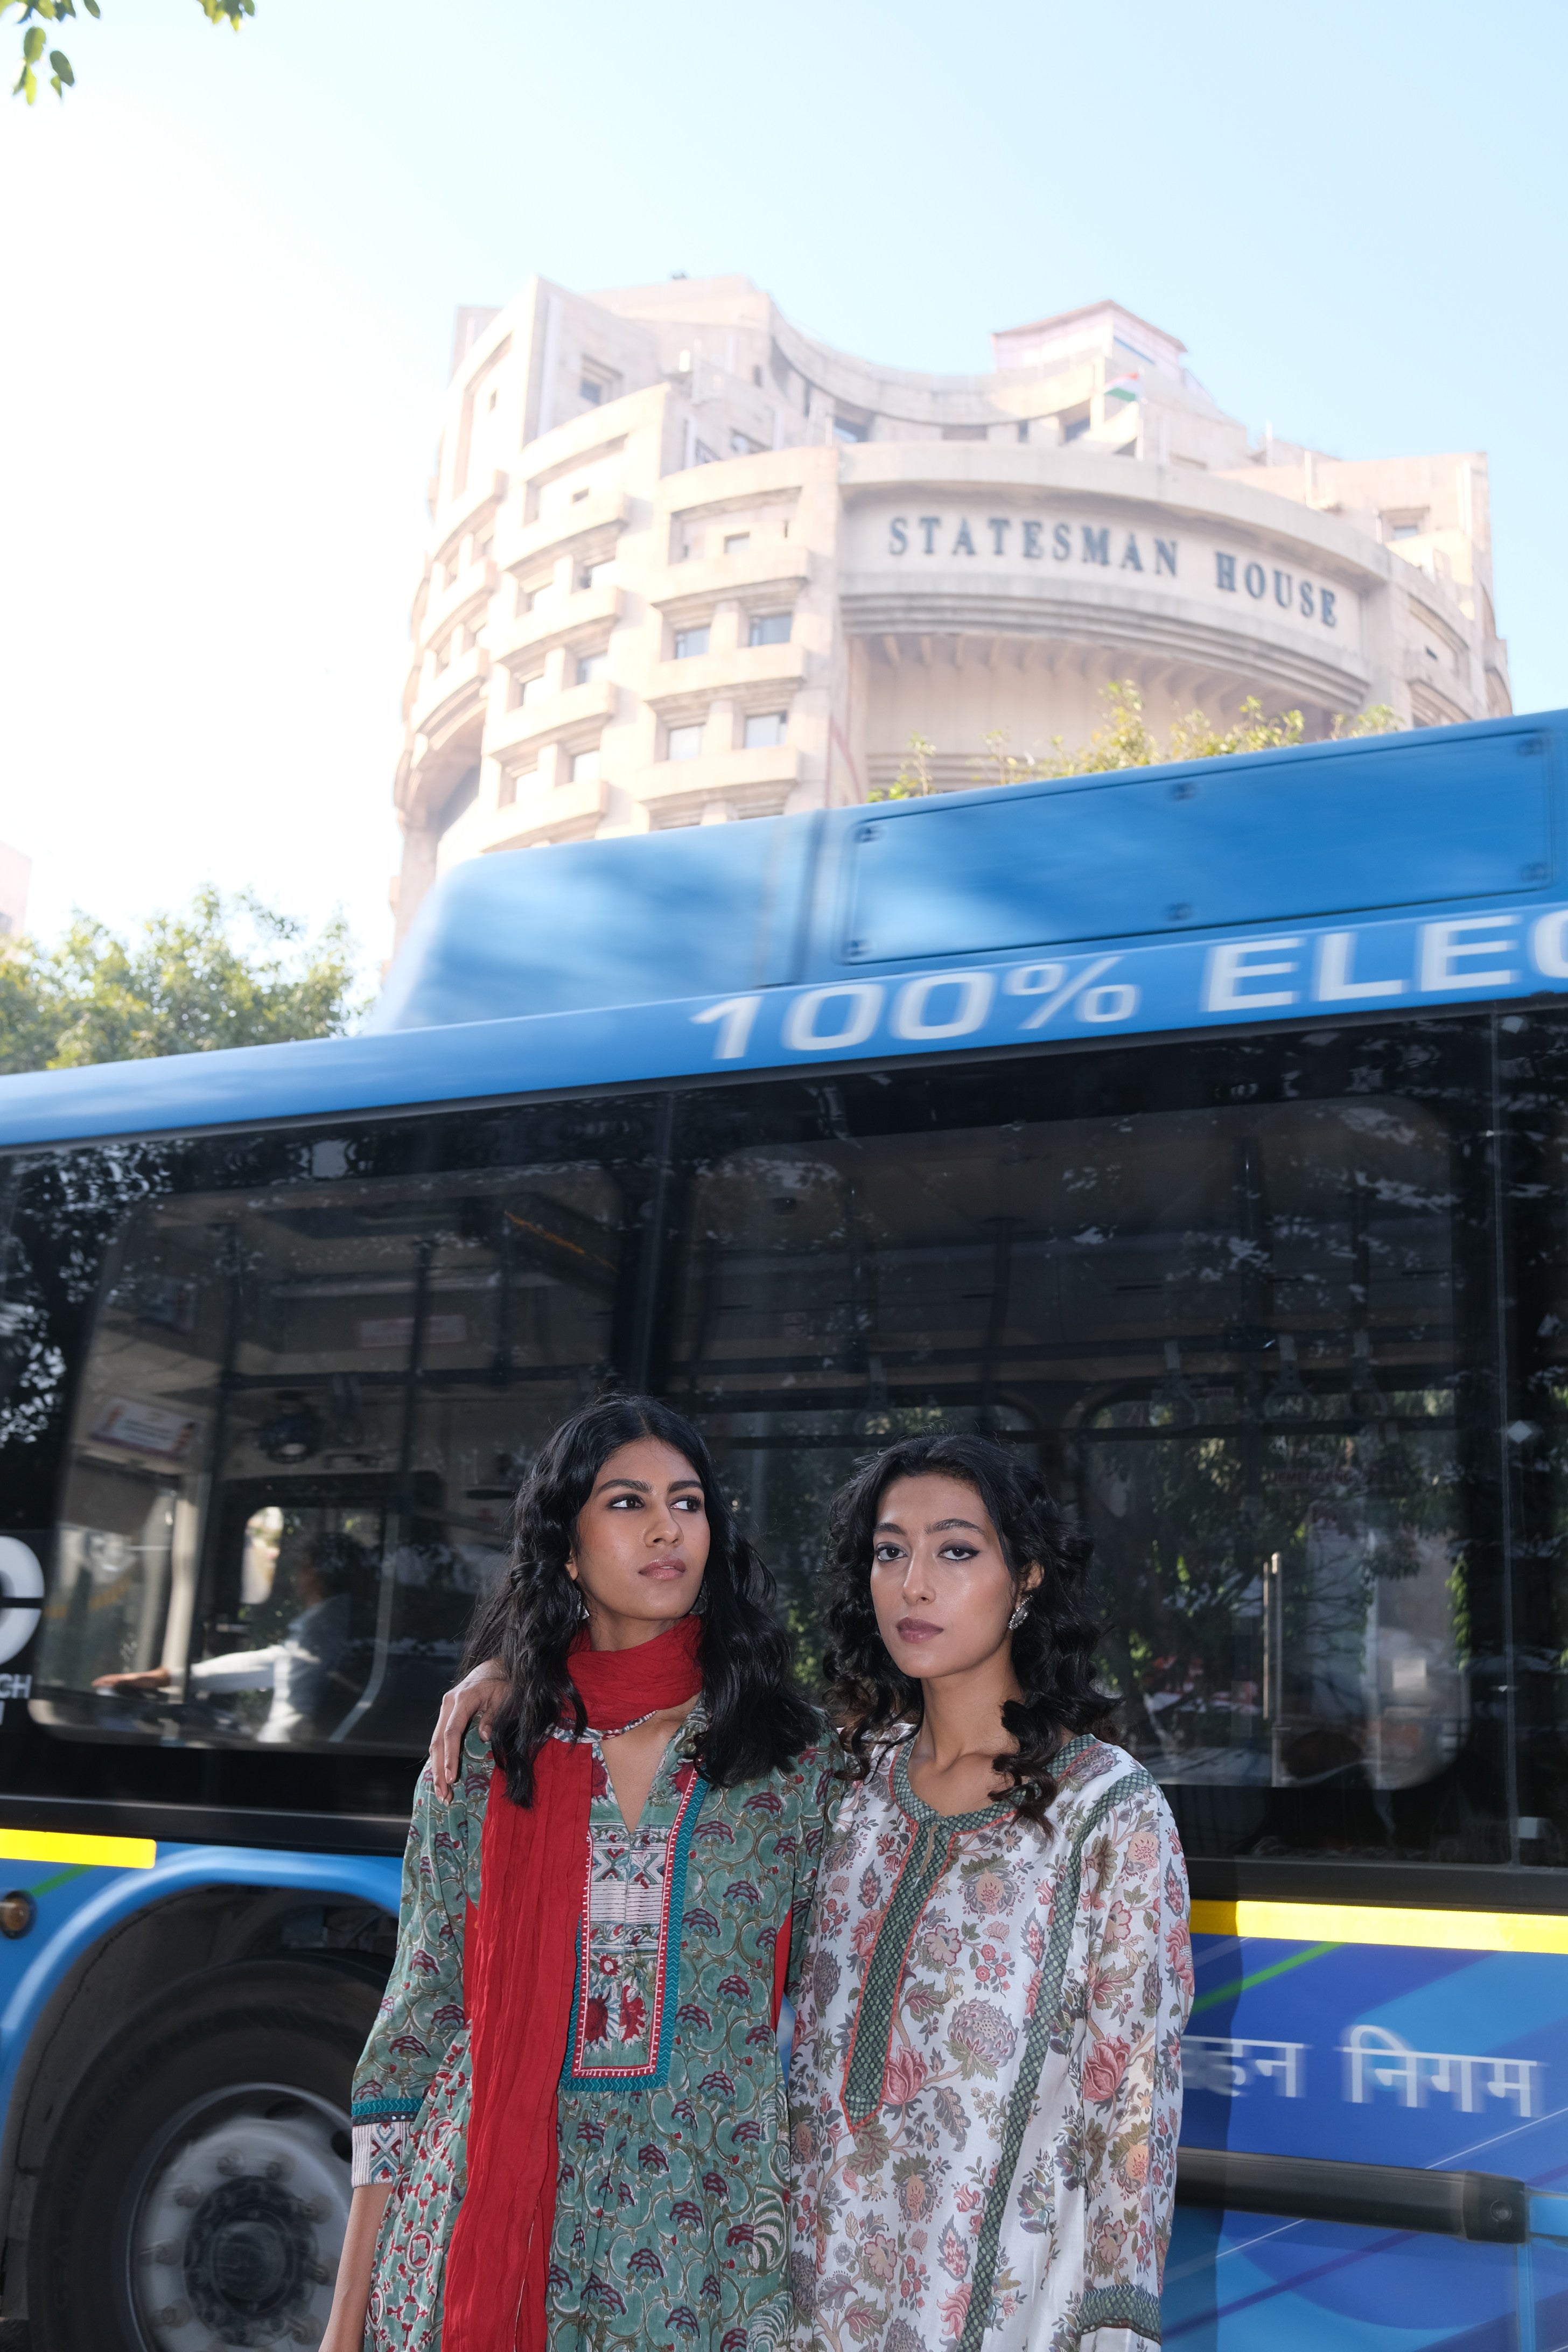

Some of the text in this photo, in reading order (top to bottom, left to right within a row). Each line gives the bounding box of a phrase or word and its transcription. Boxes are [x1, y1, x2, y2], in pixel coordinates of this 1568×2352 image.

[889, 516, 1338, 628] STATESMAN HOUSE
[691, 956, 1140, 1059] 100%
[1341, 2025, 1539, 2118] निगम
